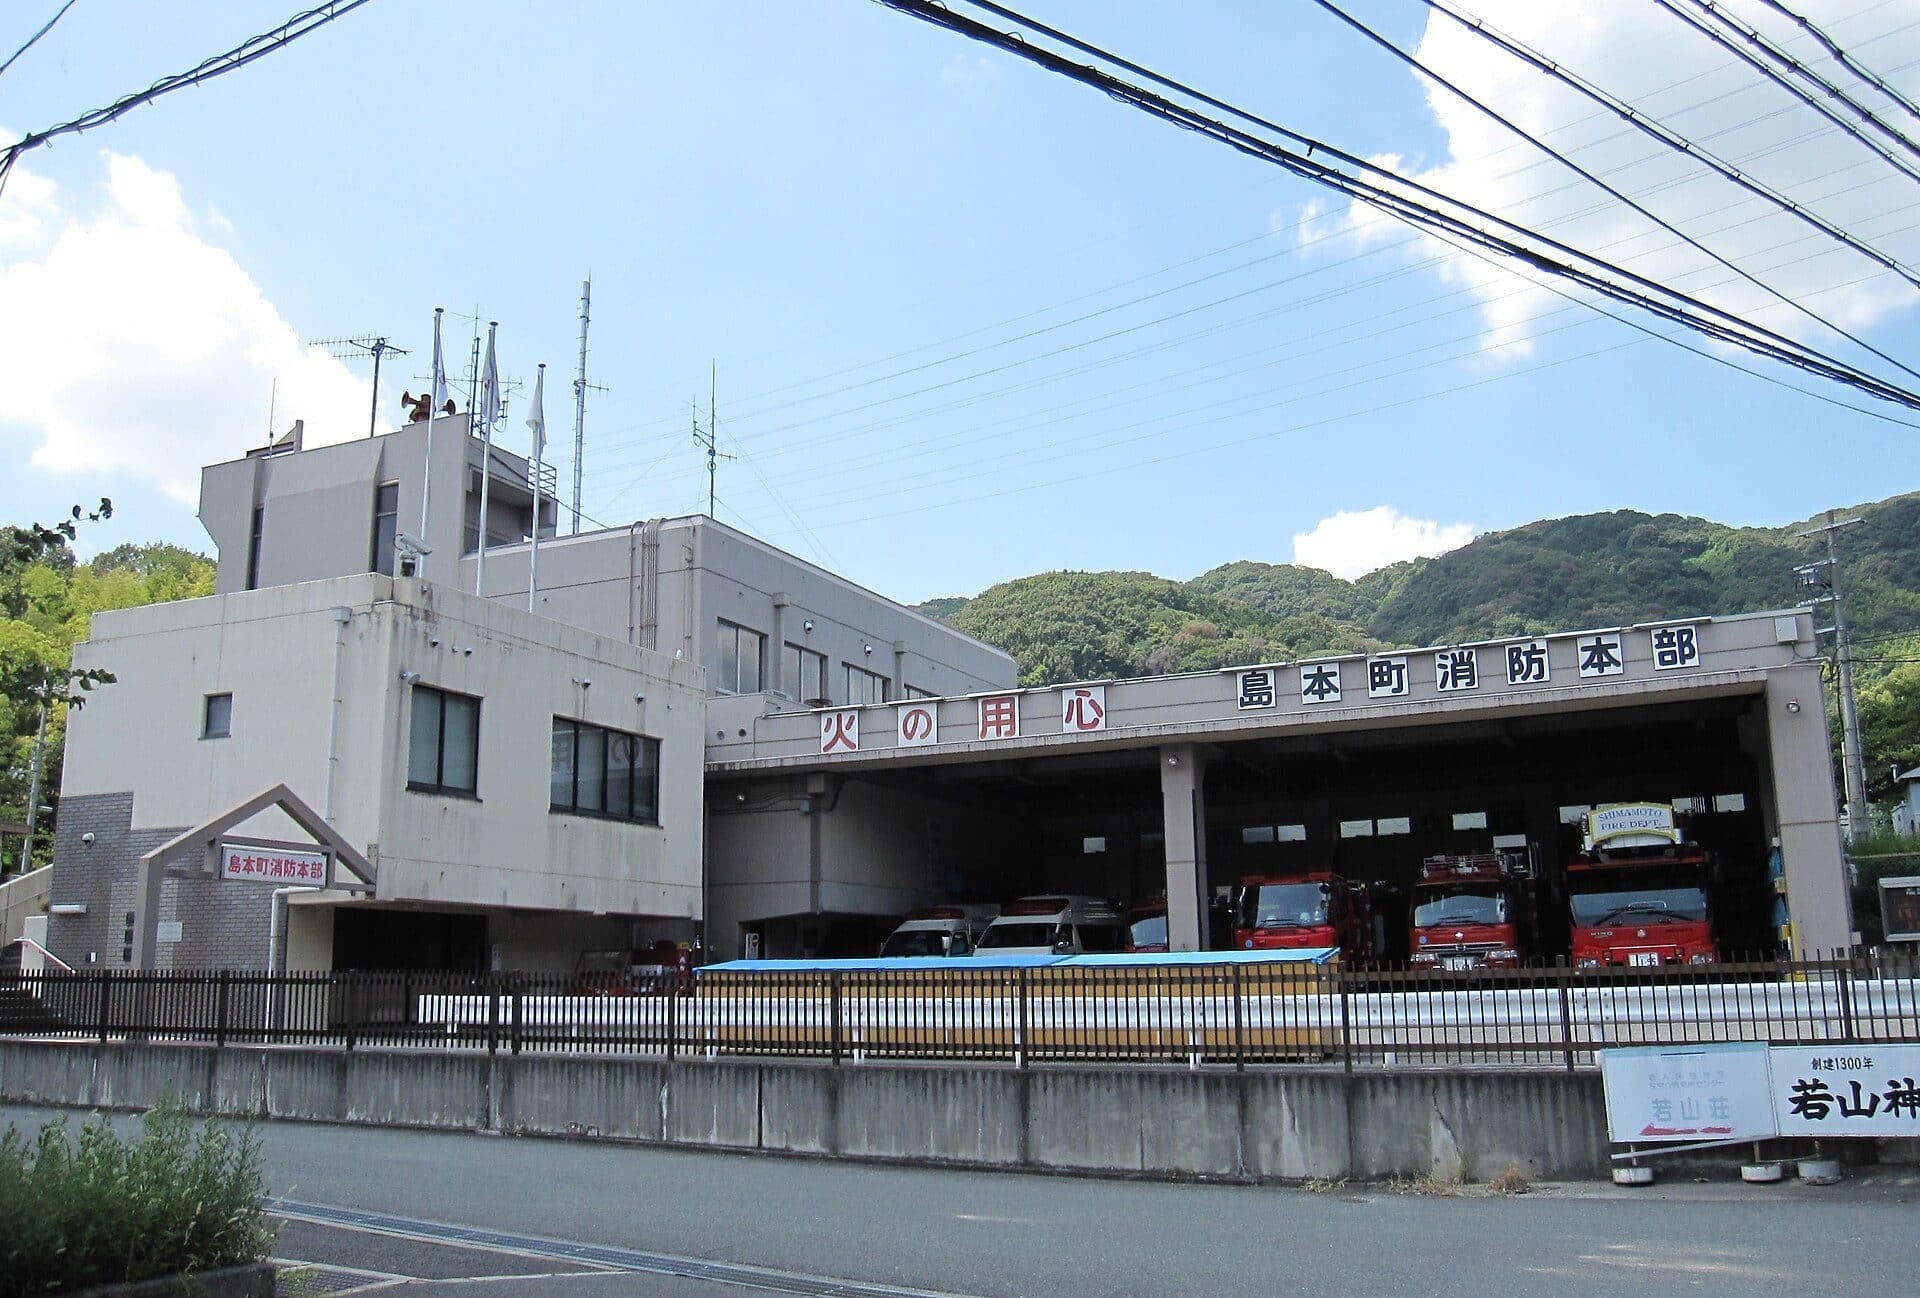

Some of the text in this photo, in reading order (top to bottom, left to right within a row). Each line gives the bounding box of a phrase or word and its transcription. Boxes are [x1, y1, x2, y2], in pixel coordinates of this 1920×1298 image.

[1239, 628, 1697, 709] 島本町消防本部
[823, 689, 1103, 753] 火の用心
[1598, 809, 1662, 822] SHIMAMOTO
[1601, 820, 1627, 831] FIRE
[228, 854, 323, 879] 島本町消防本部
